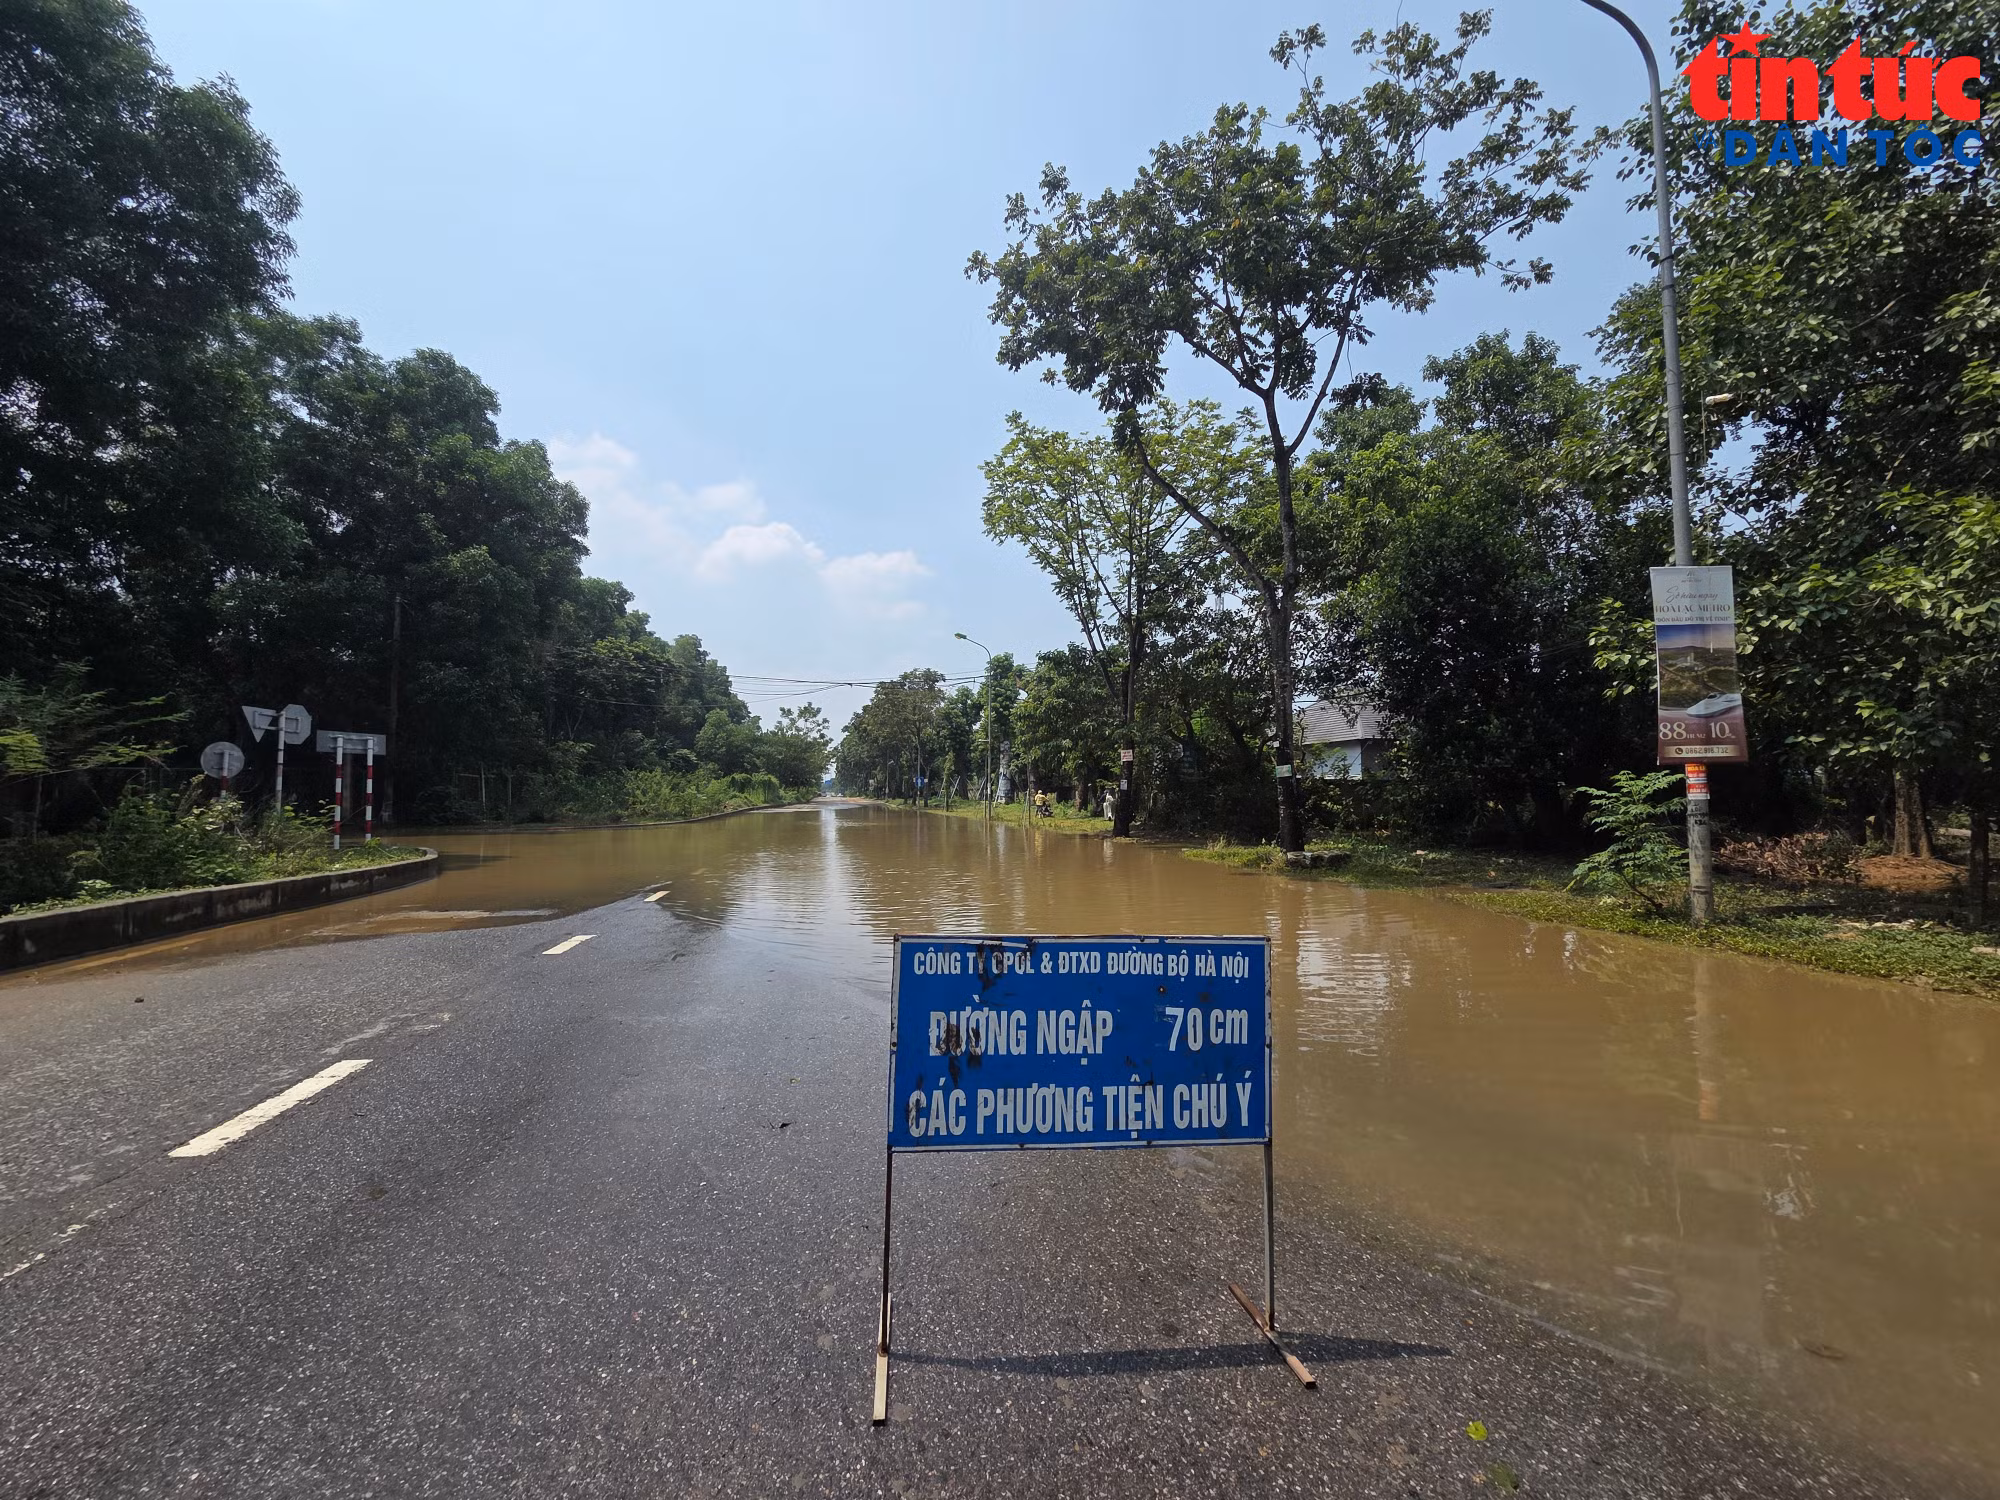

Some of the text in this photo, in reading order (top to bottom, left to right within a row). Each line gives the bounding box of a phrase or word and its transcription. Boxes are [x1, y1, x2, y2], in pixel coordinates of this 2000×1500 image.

[1659, 721, 1687, 740] 88
[1709, 721, 1730, 739] 10
[914, 947, 961, 975] CÔNG
[1041, 951, 1053, 974] &
[1058, 951, 1101, 974] ĐTXD
[1107, 945, 1164, 976] ĐƯỜNG
[1167, 949, 1189, 982] BỘ
[1195, 949, 1217, 977] HÀ
[1221, 951, 1249, 984] NỘI
[929, 994, 1249, 1066] ĐƯỜNG NGẬP 70 cm
[908, 1070, 1252, 1139] CÁC PHƯƠNG TIỆN CHÚ Ý
